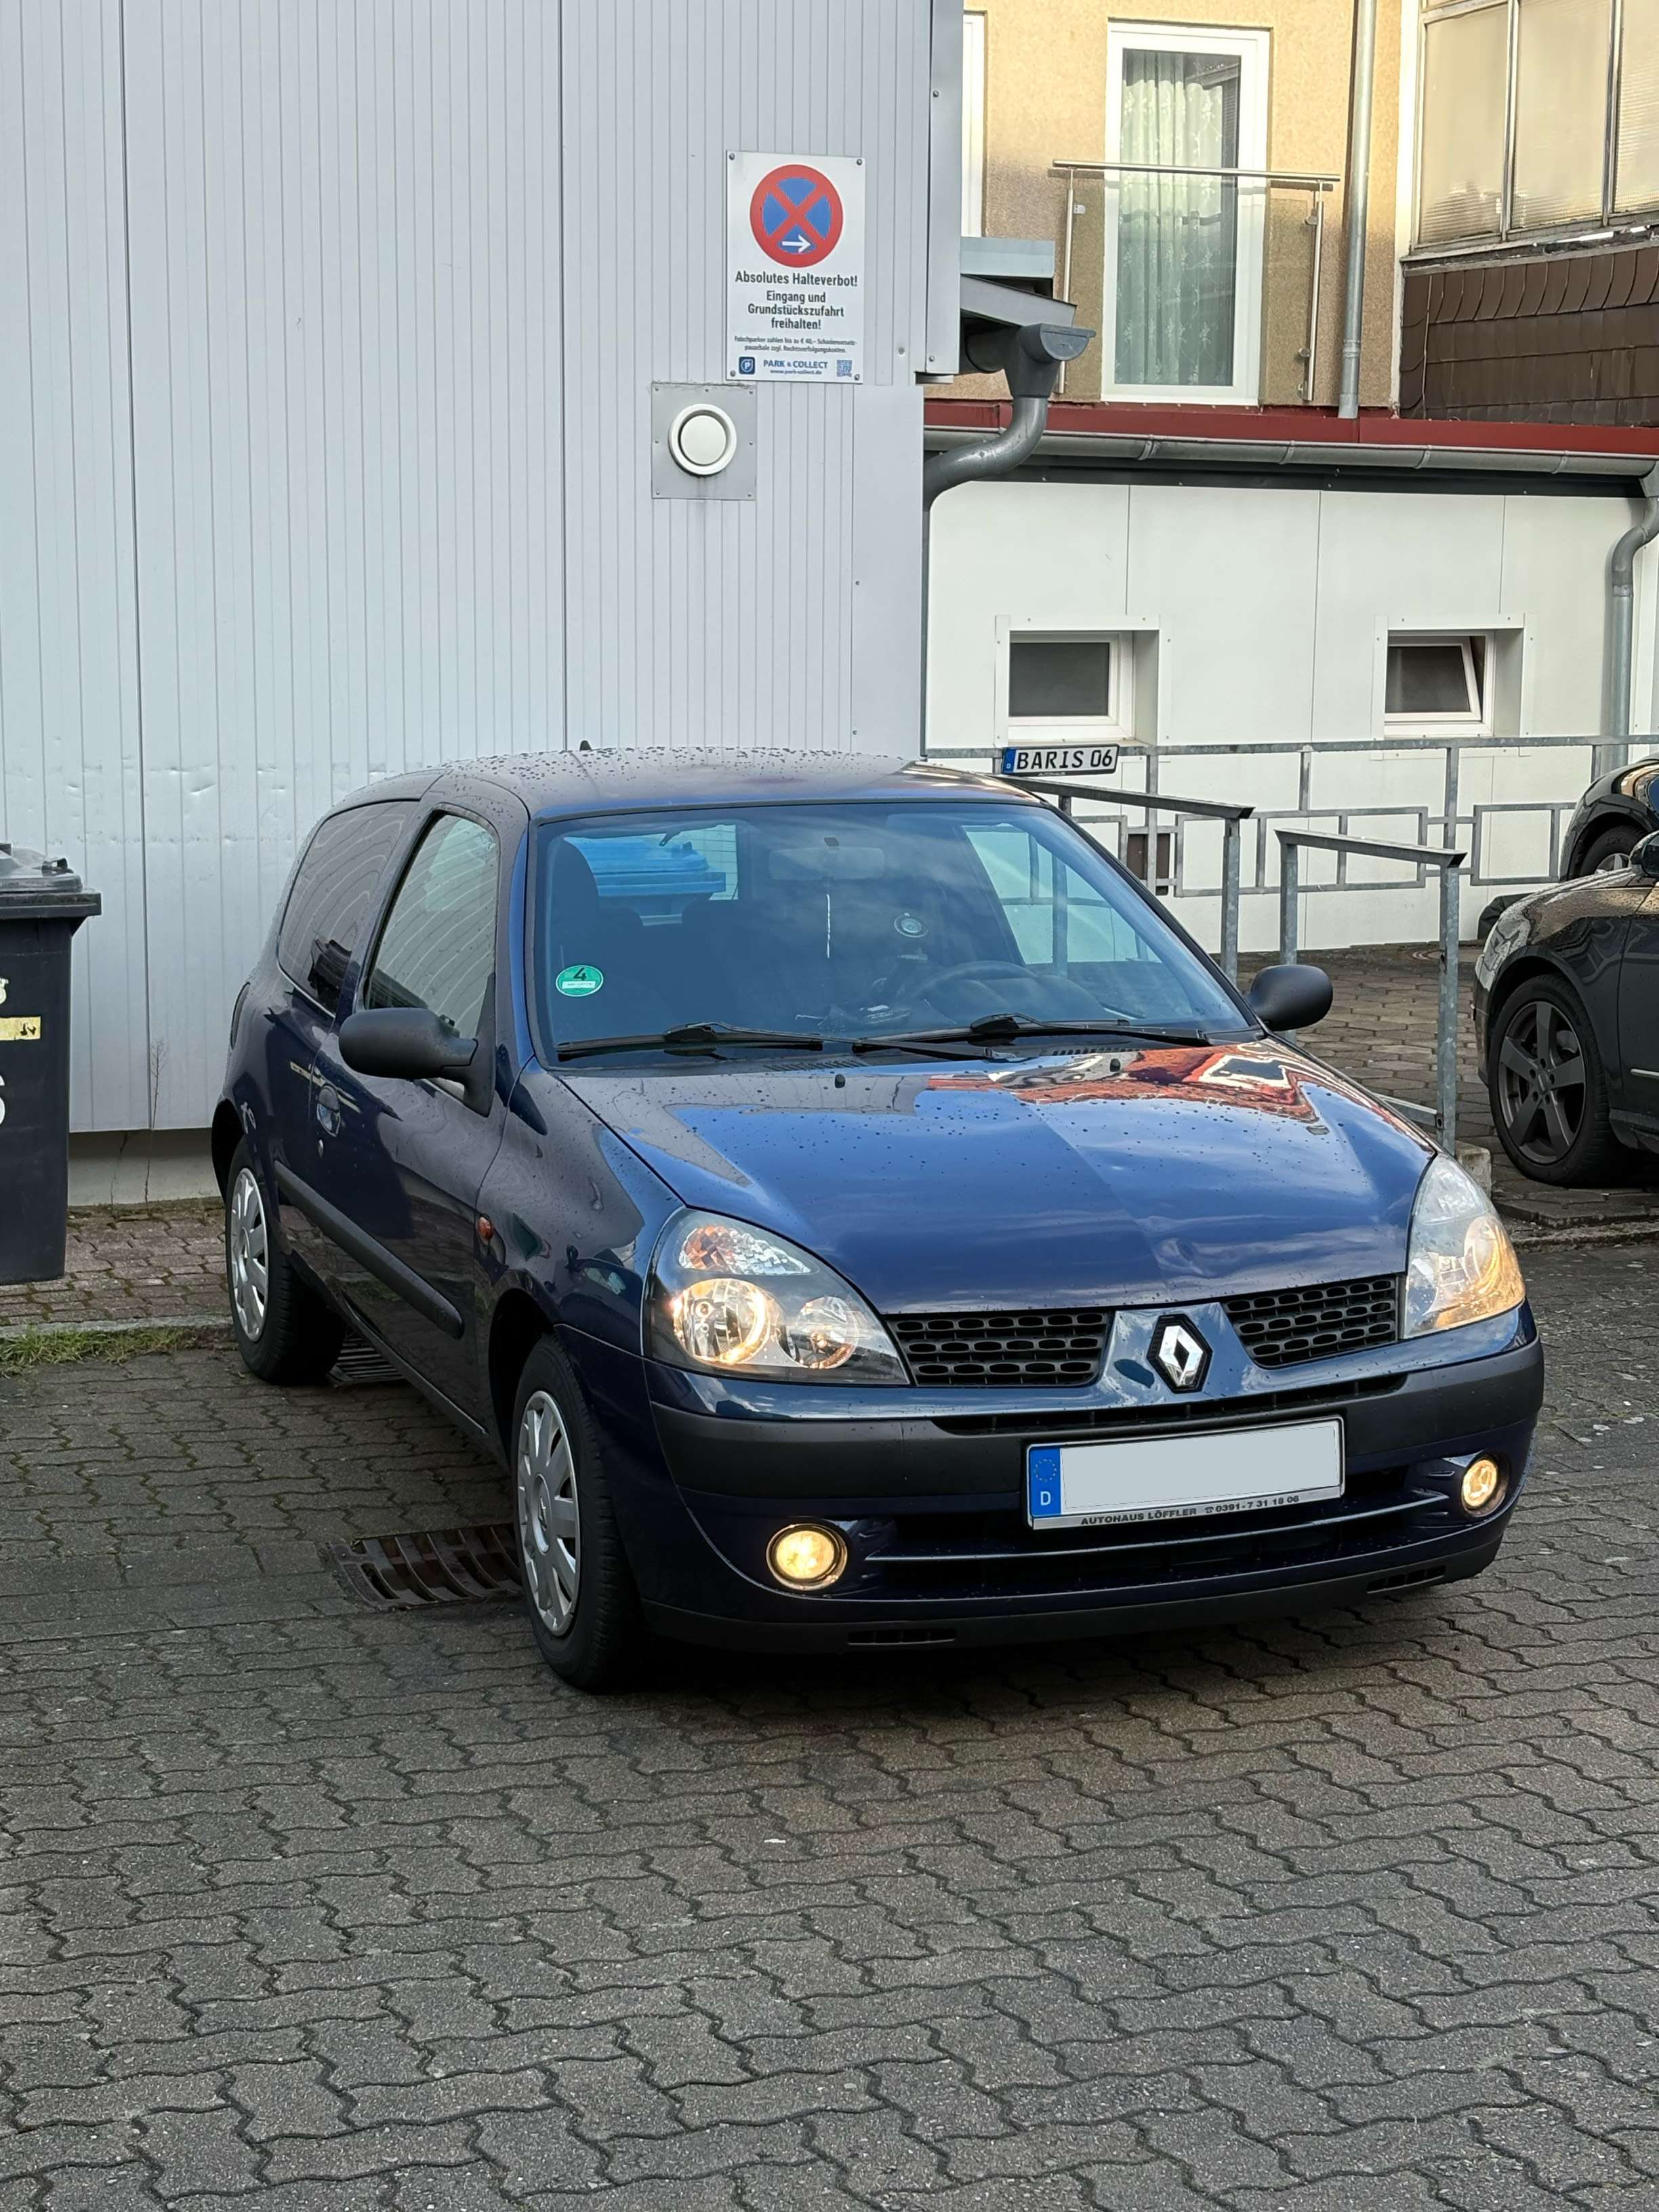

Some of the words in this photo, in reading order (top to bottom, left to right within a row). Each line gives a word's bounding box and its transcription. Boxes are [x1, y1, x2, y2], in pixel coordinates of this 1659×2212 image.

[735, 270, 790, 284] Absolutes
[792, 273, 858, 287] Halteverbot!
[766, 290, 805, 304] Eingang
[808, 291, 826, 303] und
[747, 303, 844, 317] Grundstückszufahrt
[771, 317, 821, 330] freihalten!
[763, 359, 785, 368] PARK
[792, 361, 828, 369] COLLECT
[1017, 750, 1084, 770] BARIS
[1090, 749, 1113, 768] 06
[573, 967, 587, 981] 4
[1040, 1491, 1052, 1507] D
[1081, 1512, 1145, 1525] AUTOHAUS
[1147, 1507, 1197, 1520] LÖFFLER
[1256, 1499, 1268, 1508] 31
